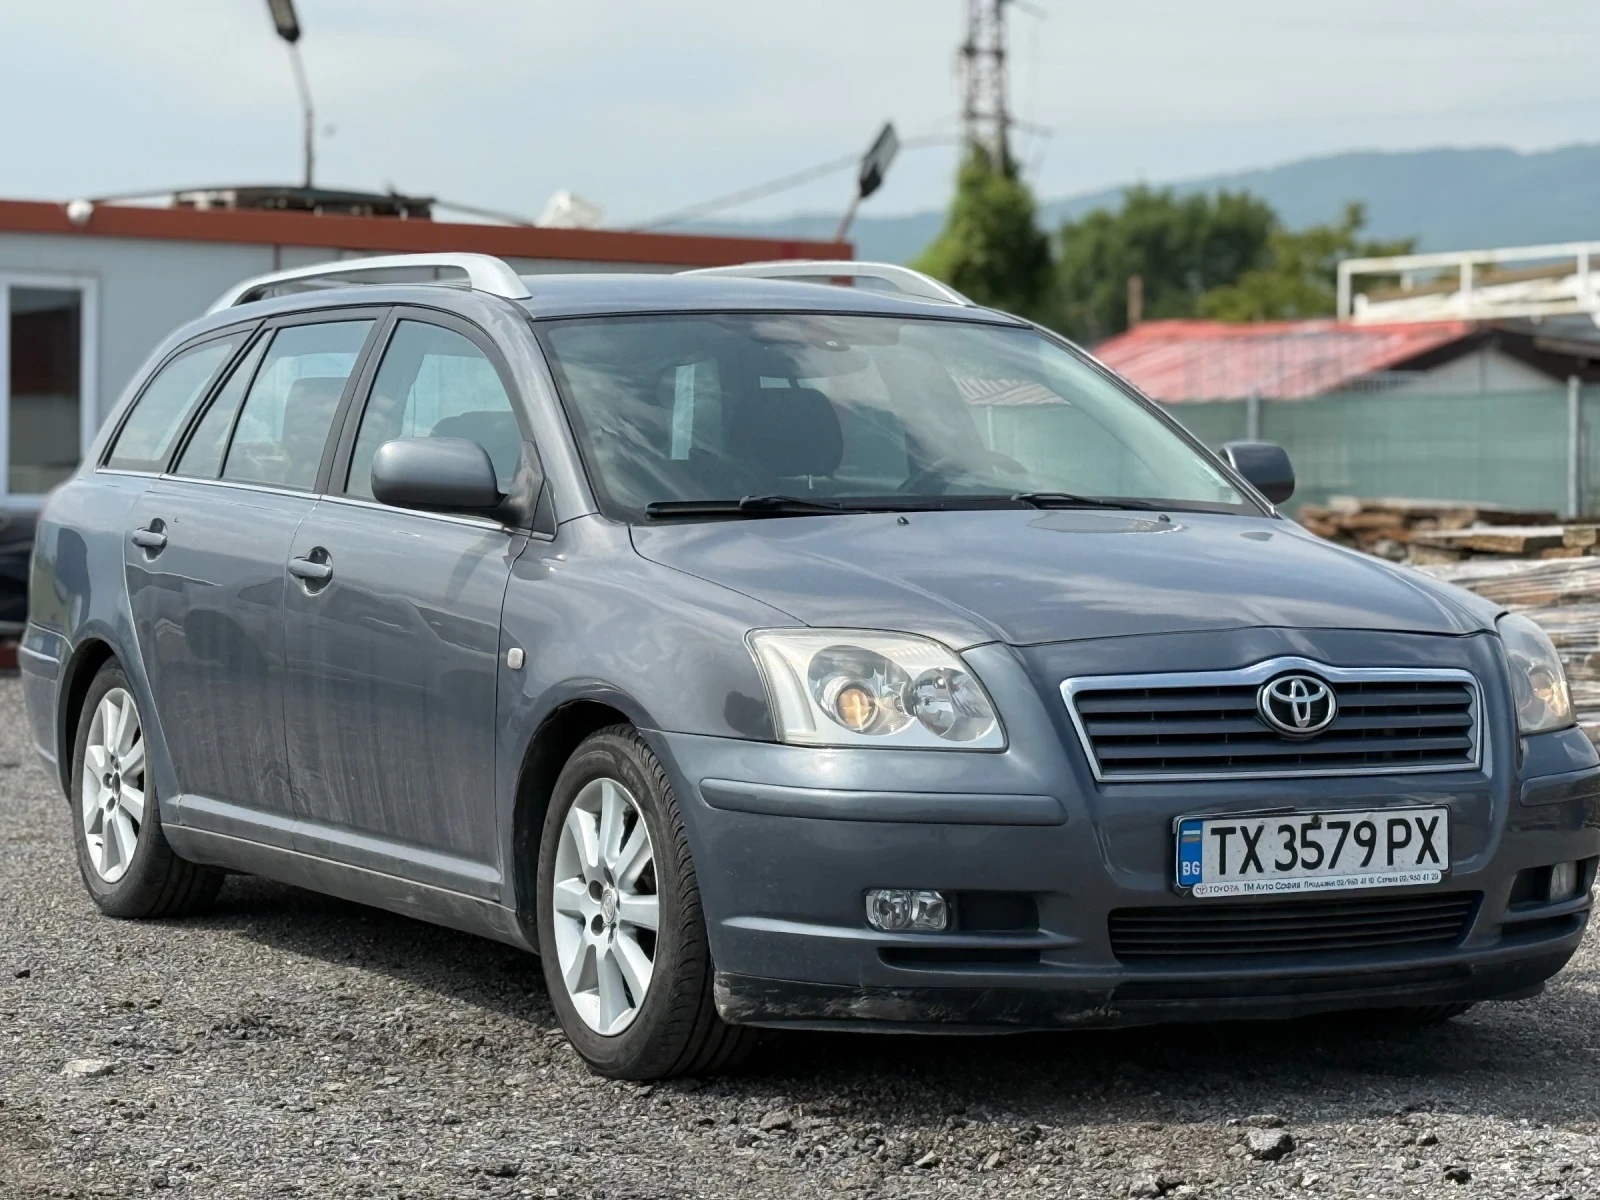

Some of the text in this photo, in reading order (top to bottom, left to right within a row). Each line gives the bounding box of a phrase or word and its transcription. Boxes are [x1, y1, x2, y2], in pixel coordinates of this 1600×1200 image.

[1210, 815, 1441, 876] TX 3579 PX
[1182, 861, 1200, 876] BG
[1209, 884, 1240, 893] TOYOTA
